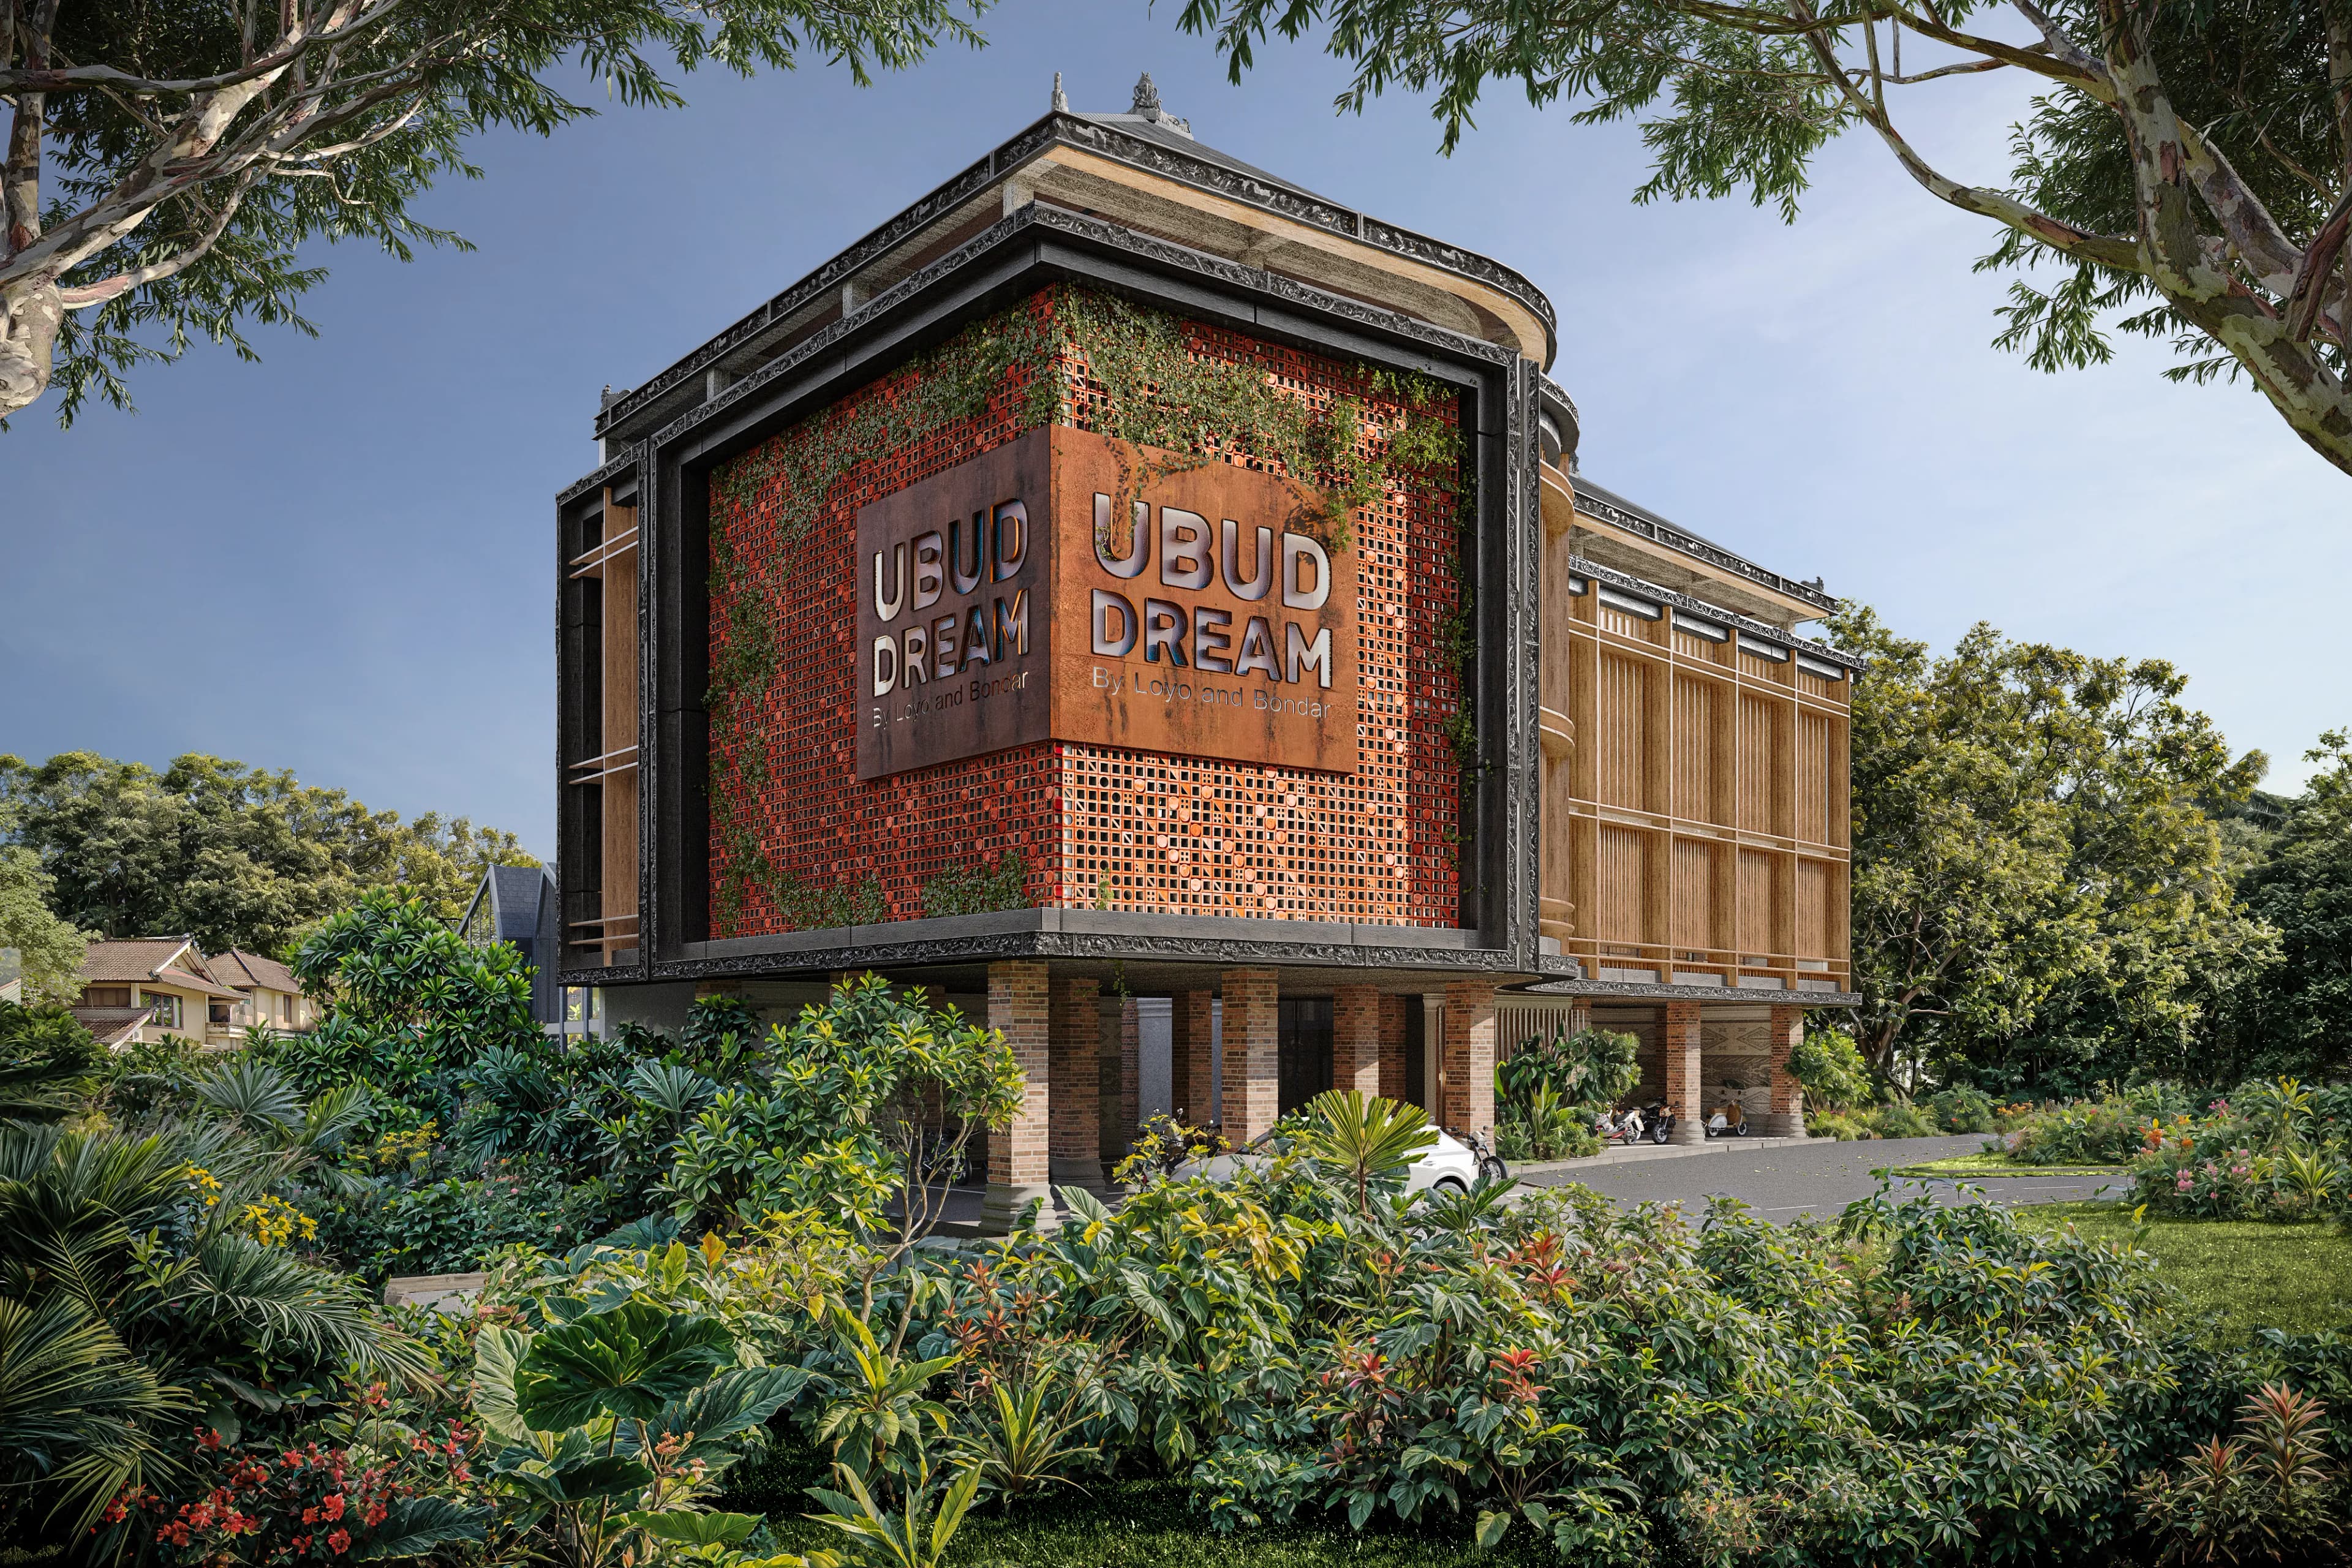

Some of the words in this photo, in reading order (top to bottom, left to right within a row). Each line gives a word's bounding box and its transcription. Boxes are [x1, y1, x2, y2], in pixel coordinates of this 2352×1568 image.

[873, 497, 1028, 622] UBUD
[1093, 492, 1332, 610] UBUD
[872, 588, 1029, 698] DREAM
[1091, 588, 1333, 688] DREAM
[873, 707, 889, 730] By
[895, 698, 930, 723] Loyo
[935, 684, 963, 710] and
[970, 671, 1028, 702] Bondar
[1093, 666, 1123, 695] By
[1134, 672, 1192, 703] Loyo
[1202, 687, 1243, 707] and
[1254, 689, 1332, 718] Bondar
